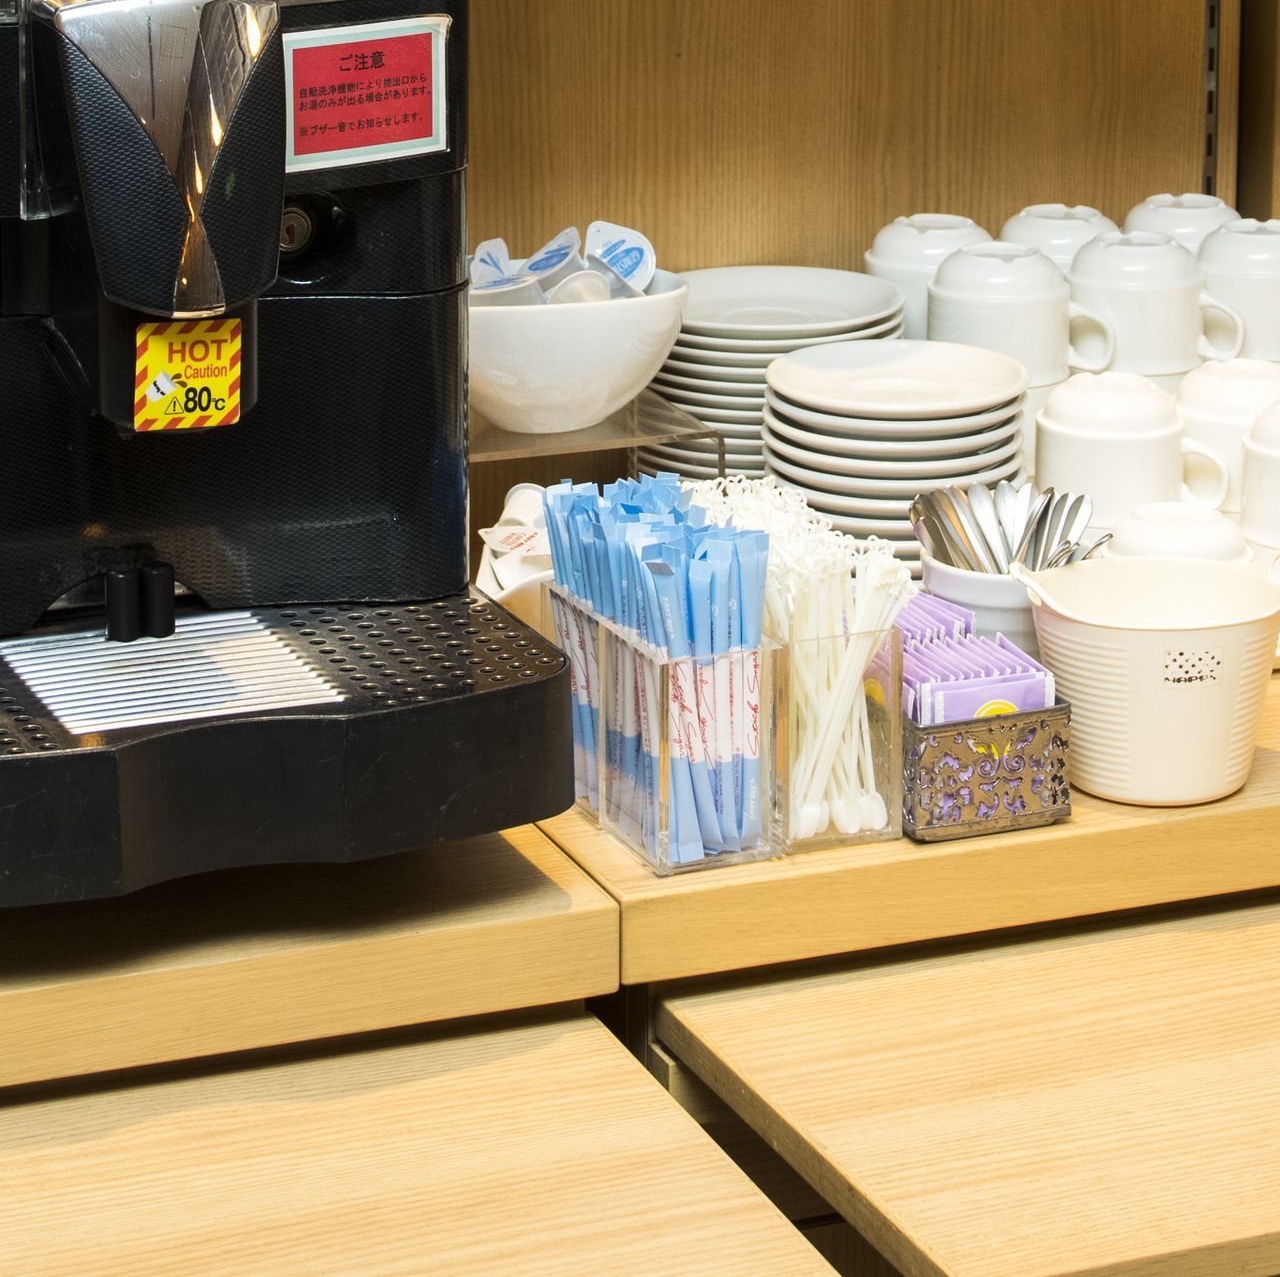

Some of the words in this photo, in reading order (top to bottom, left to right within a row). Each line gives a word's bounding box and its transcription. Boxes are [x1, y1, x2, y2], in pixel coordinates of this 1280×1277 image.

[339, 50, 385, 72] ご注意
[167, 338, 229, 364] HOT
[184, 363, 228, 380] Caution
